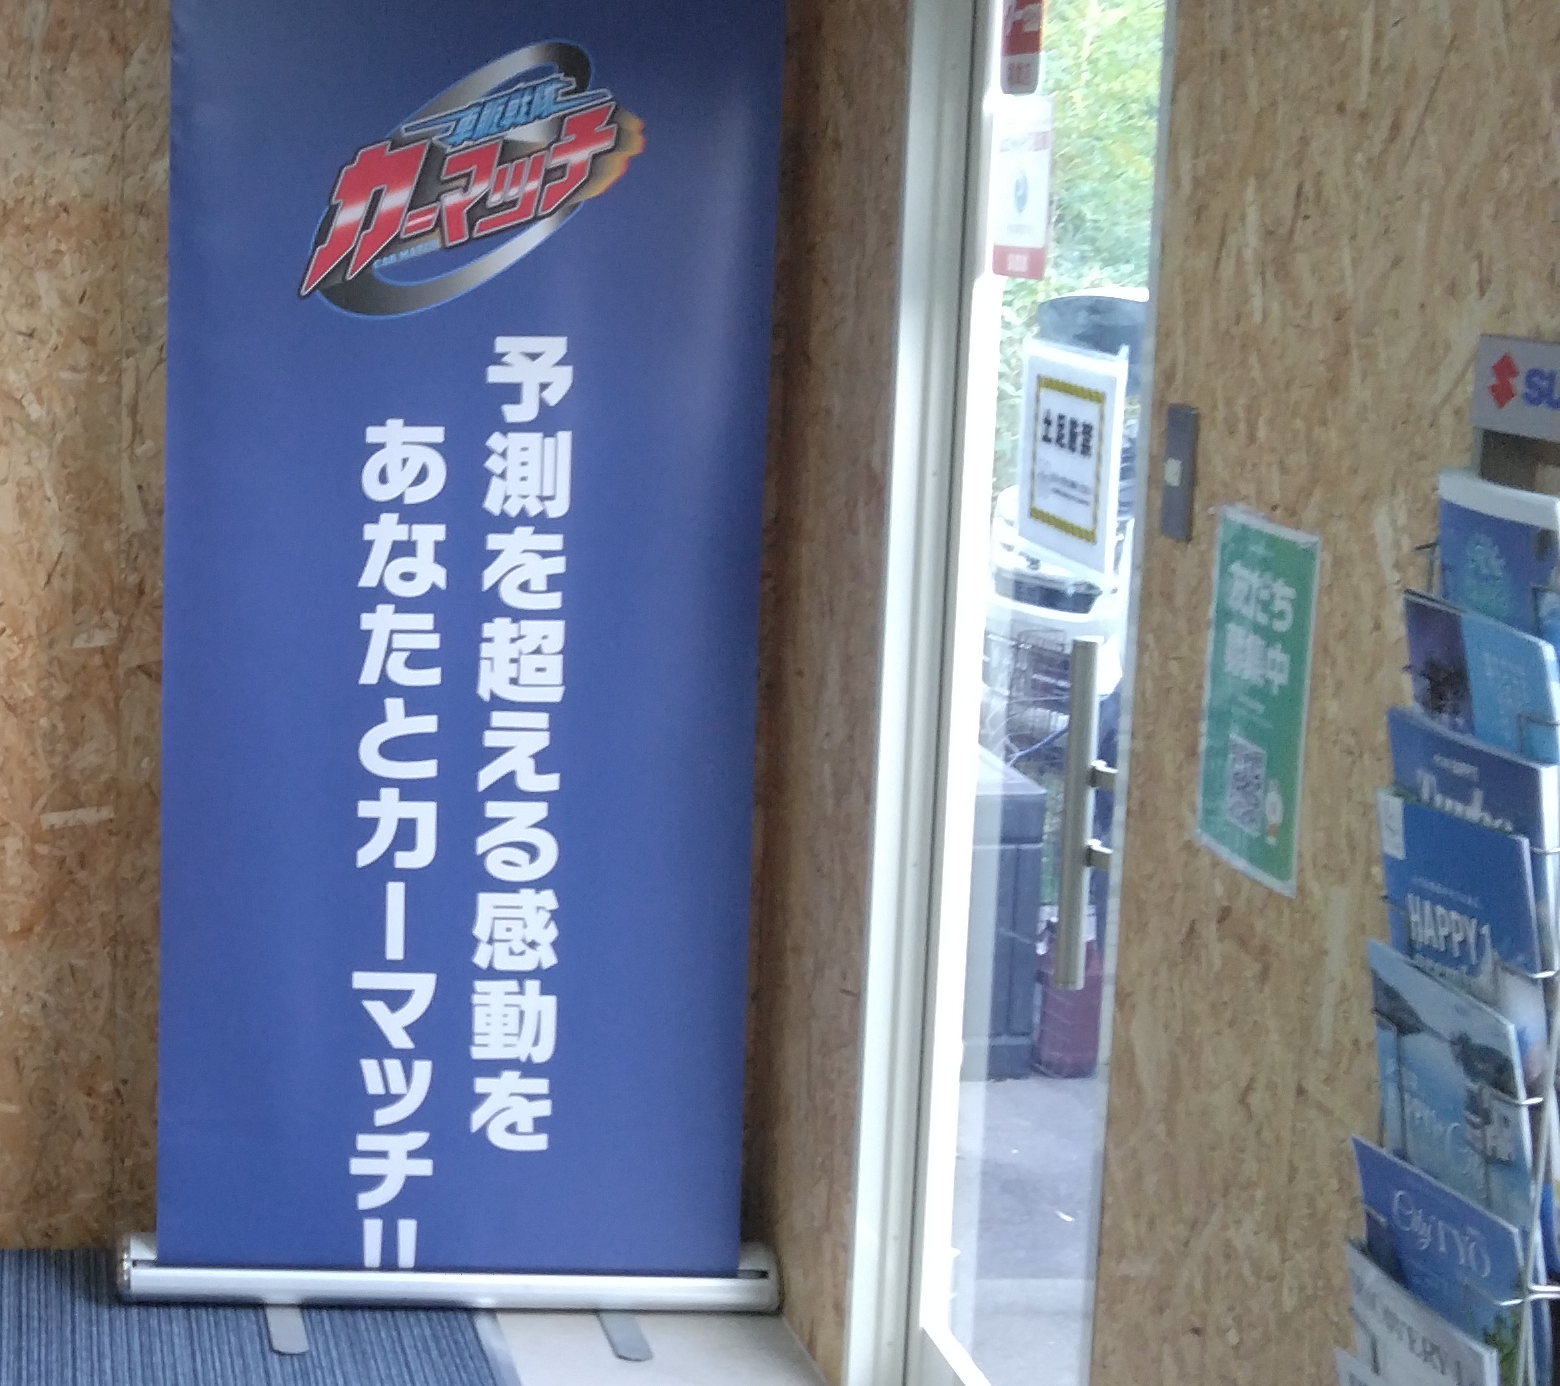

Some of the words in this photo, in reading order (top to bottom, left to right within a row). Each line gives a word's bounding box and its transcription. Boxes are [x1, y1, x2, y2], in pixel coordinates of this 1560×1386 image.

[299, 102, 618, 297] カーマッチ
[469, 336, 573, 1153] 予測を超える感動を
